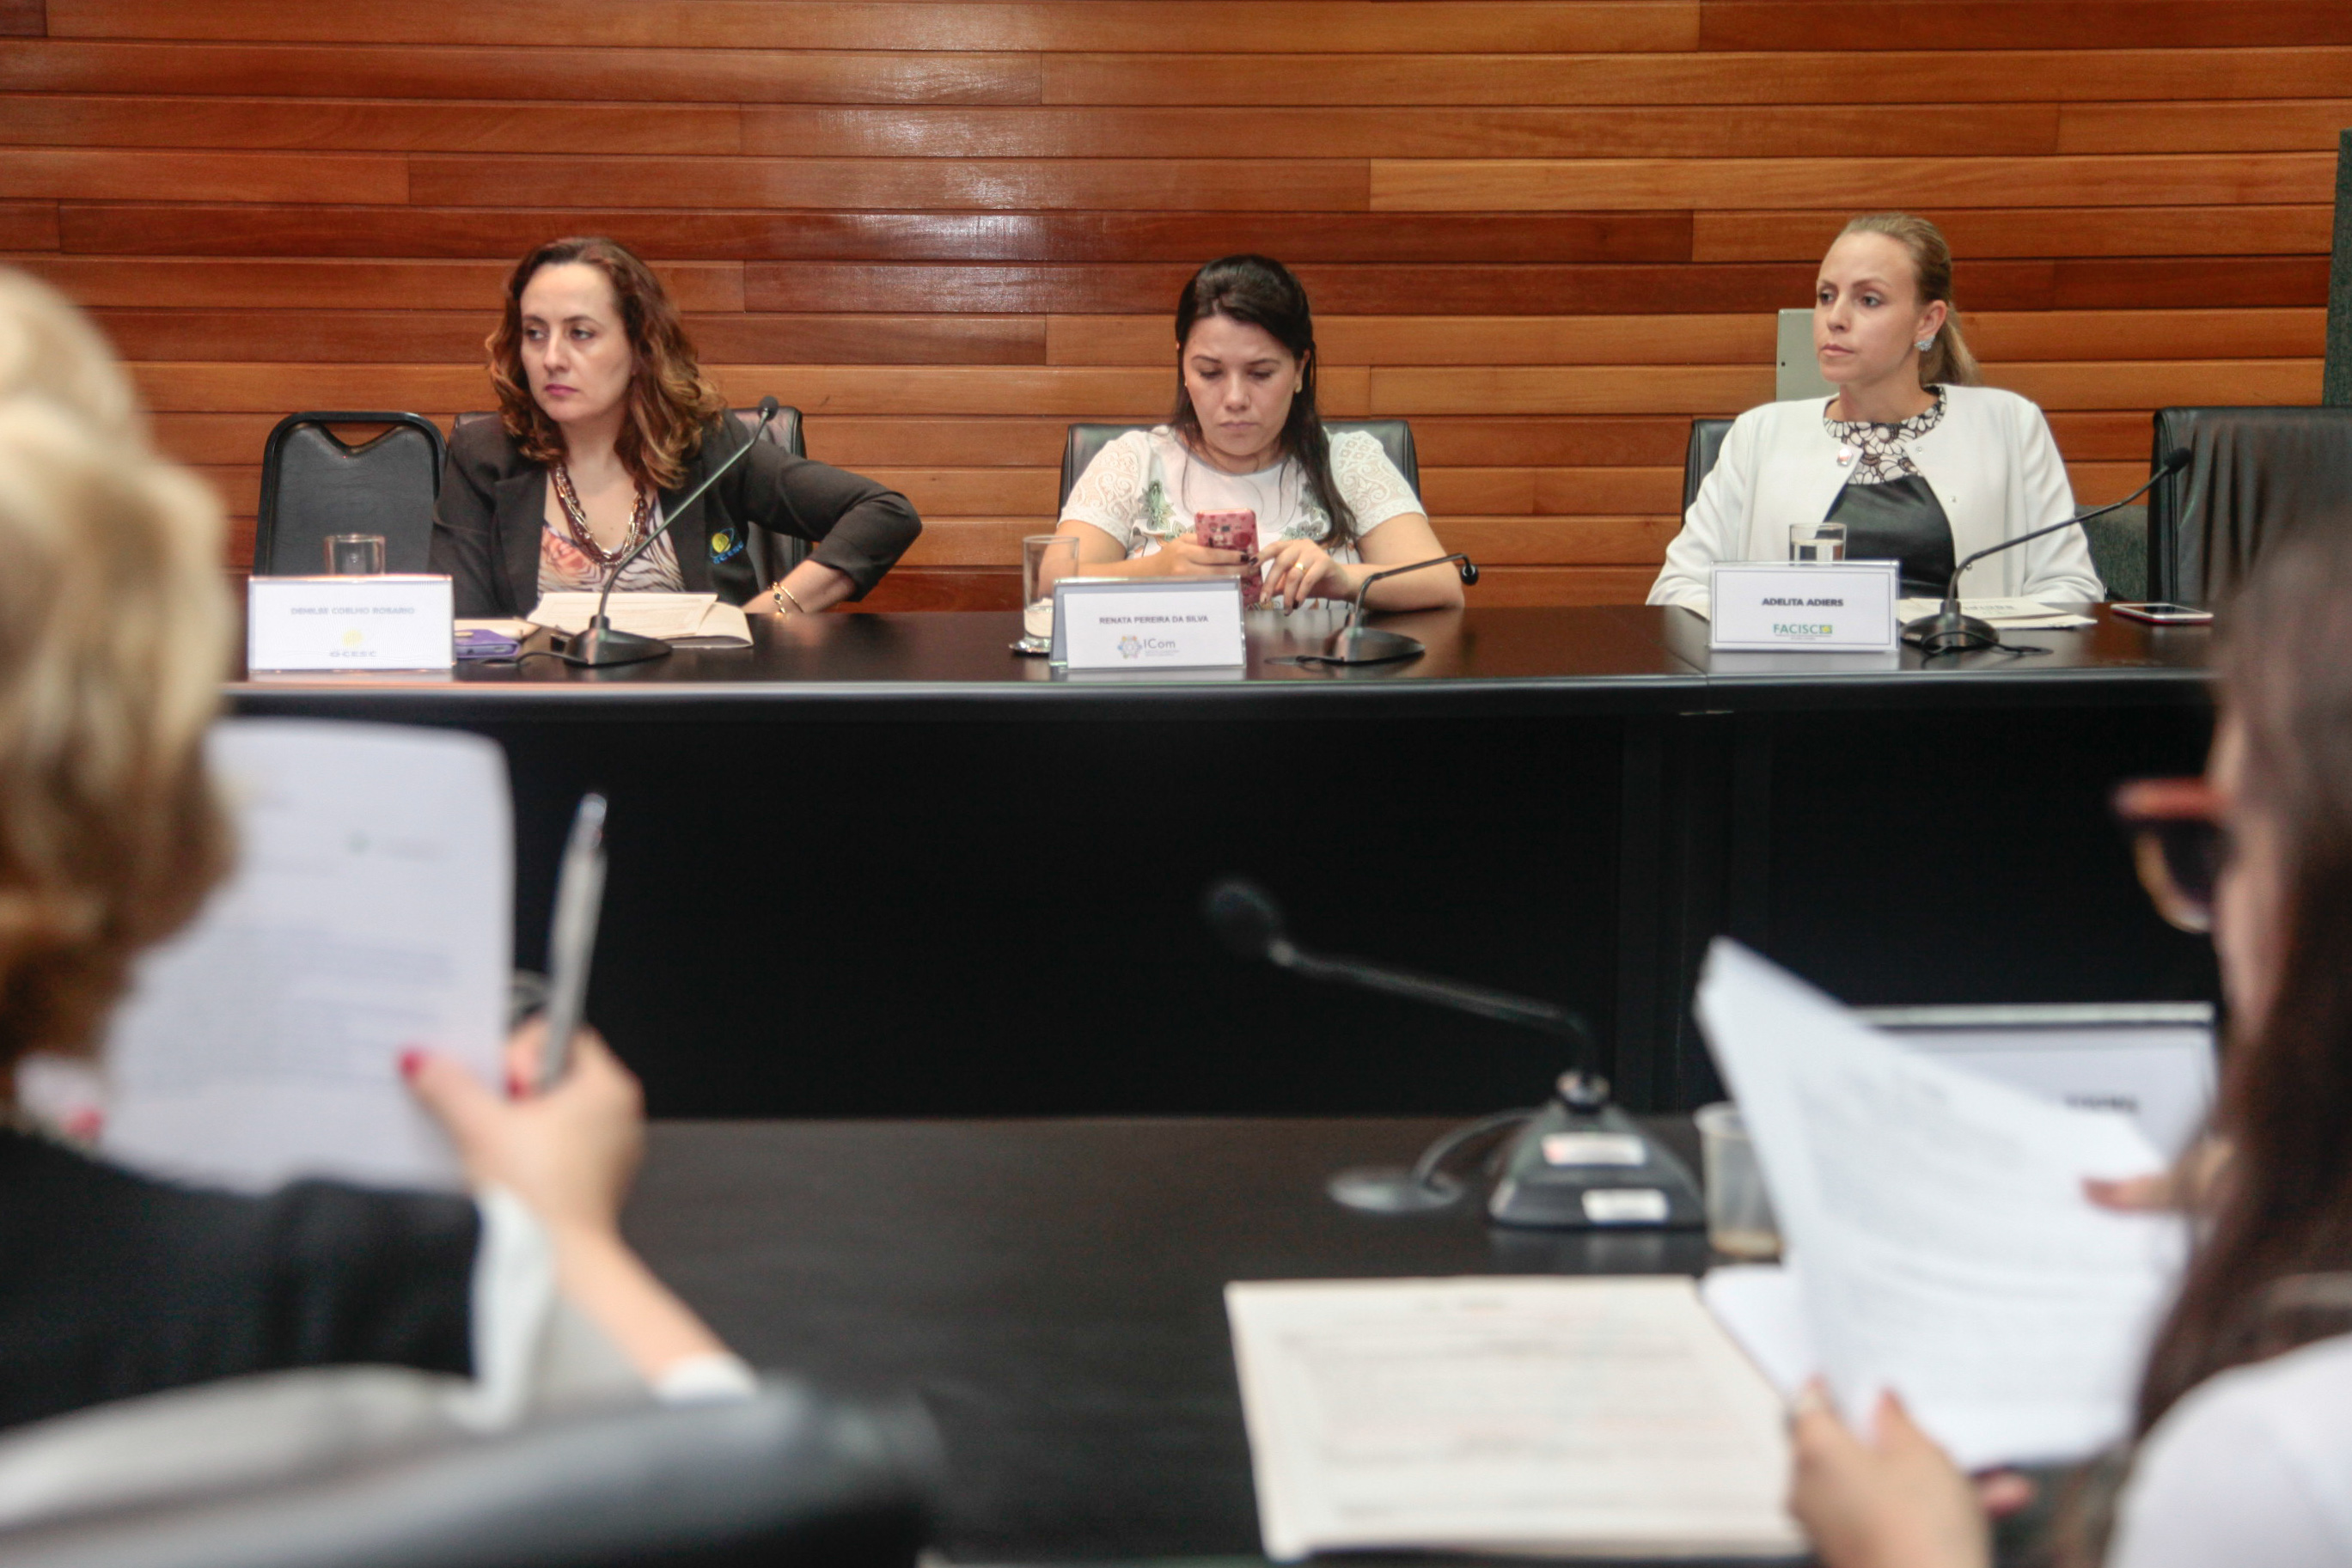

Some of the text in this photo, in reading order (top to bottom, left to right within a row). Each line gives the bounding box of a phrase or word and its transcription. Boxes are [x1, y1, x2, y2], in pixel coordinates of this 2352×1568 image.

[1762, 597, 1844, 607] ADELITA ADIERS
[332, 607, 370, 615] COELHO
[1099, 615, 1208, 625] RENATA PEREIRA DA SILVA
[1773, 623, 1820, 634] FACISC
[1144, 638, 1176, 649] ICom
